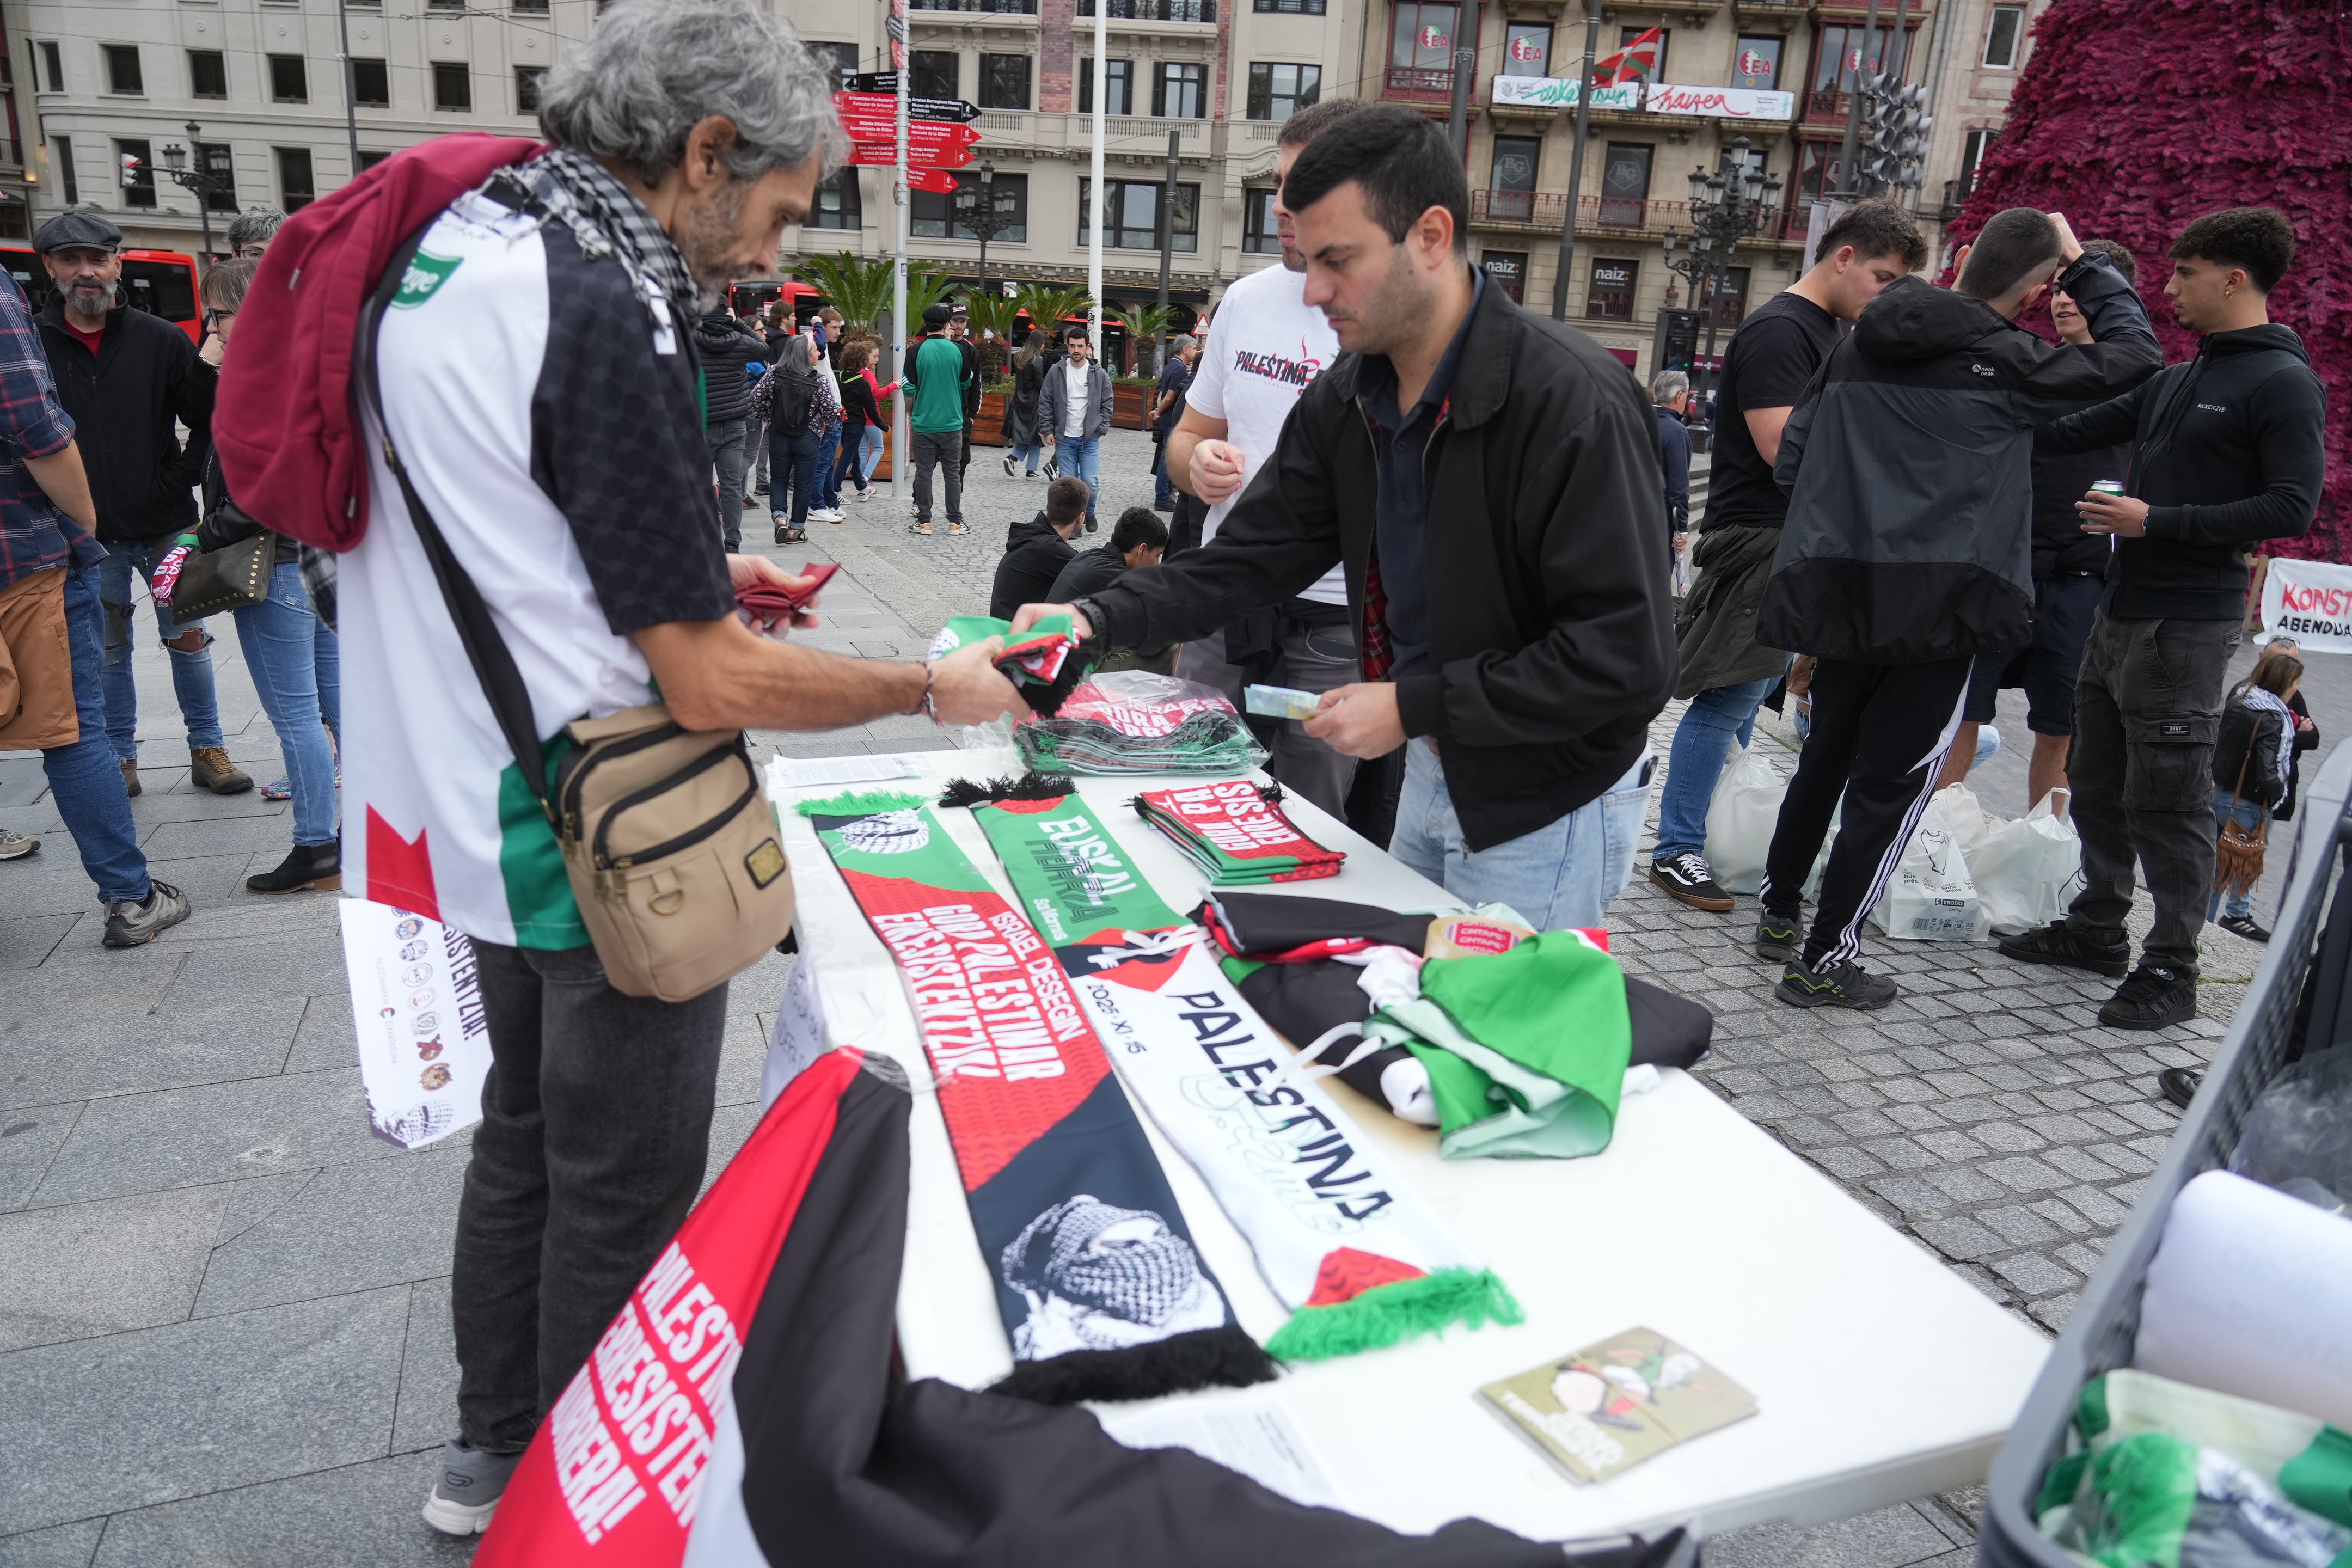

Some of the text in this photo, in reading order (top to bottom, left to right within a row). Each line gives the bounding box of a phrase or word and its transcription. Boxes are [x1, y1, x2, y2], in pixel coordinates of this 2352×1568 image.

[1432, 34, 1449, 47] EA
[1523, 46, 1542, 62] EA
[1751, 59, 1772, 75] EA
[1234, 350, 1309, 387] PALESTINA
[2197, 403, 2226, 412] MCKENZIE
[1037, 814, 1137, 906] EUSKAL
[988, 910, 1042, 961] ISRAEL
[954, 941, 1066, 1082] PALESTINAR
[1025, 956, 1088, 1042] DESEGIN
[1166, 991, 1394, 1221] PALESTINA
